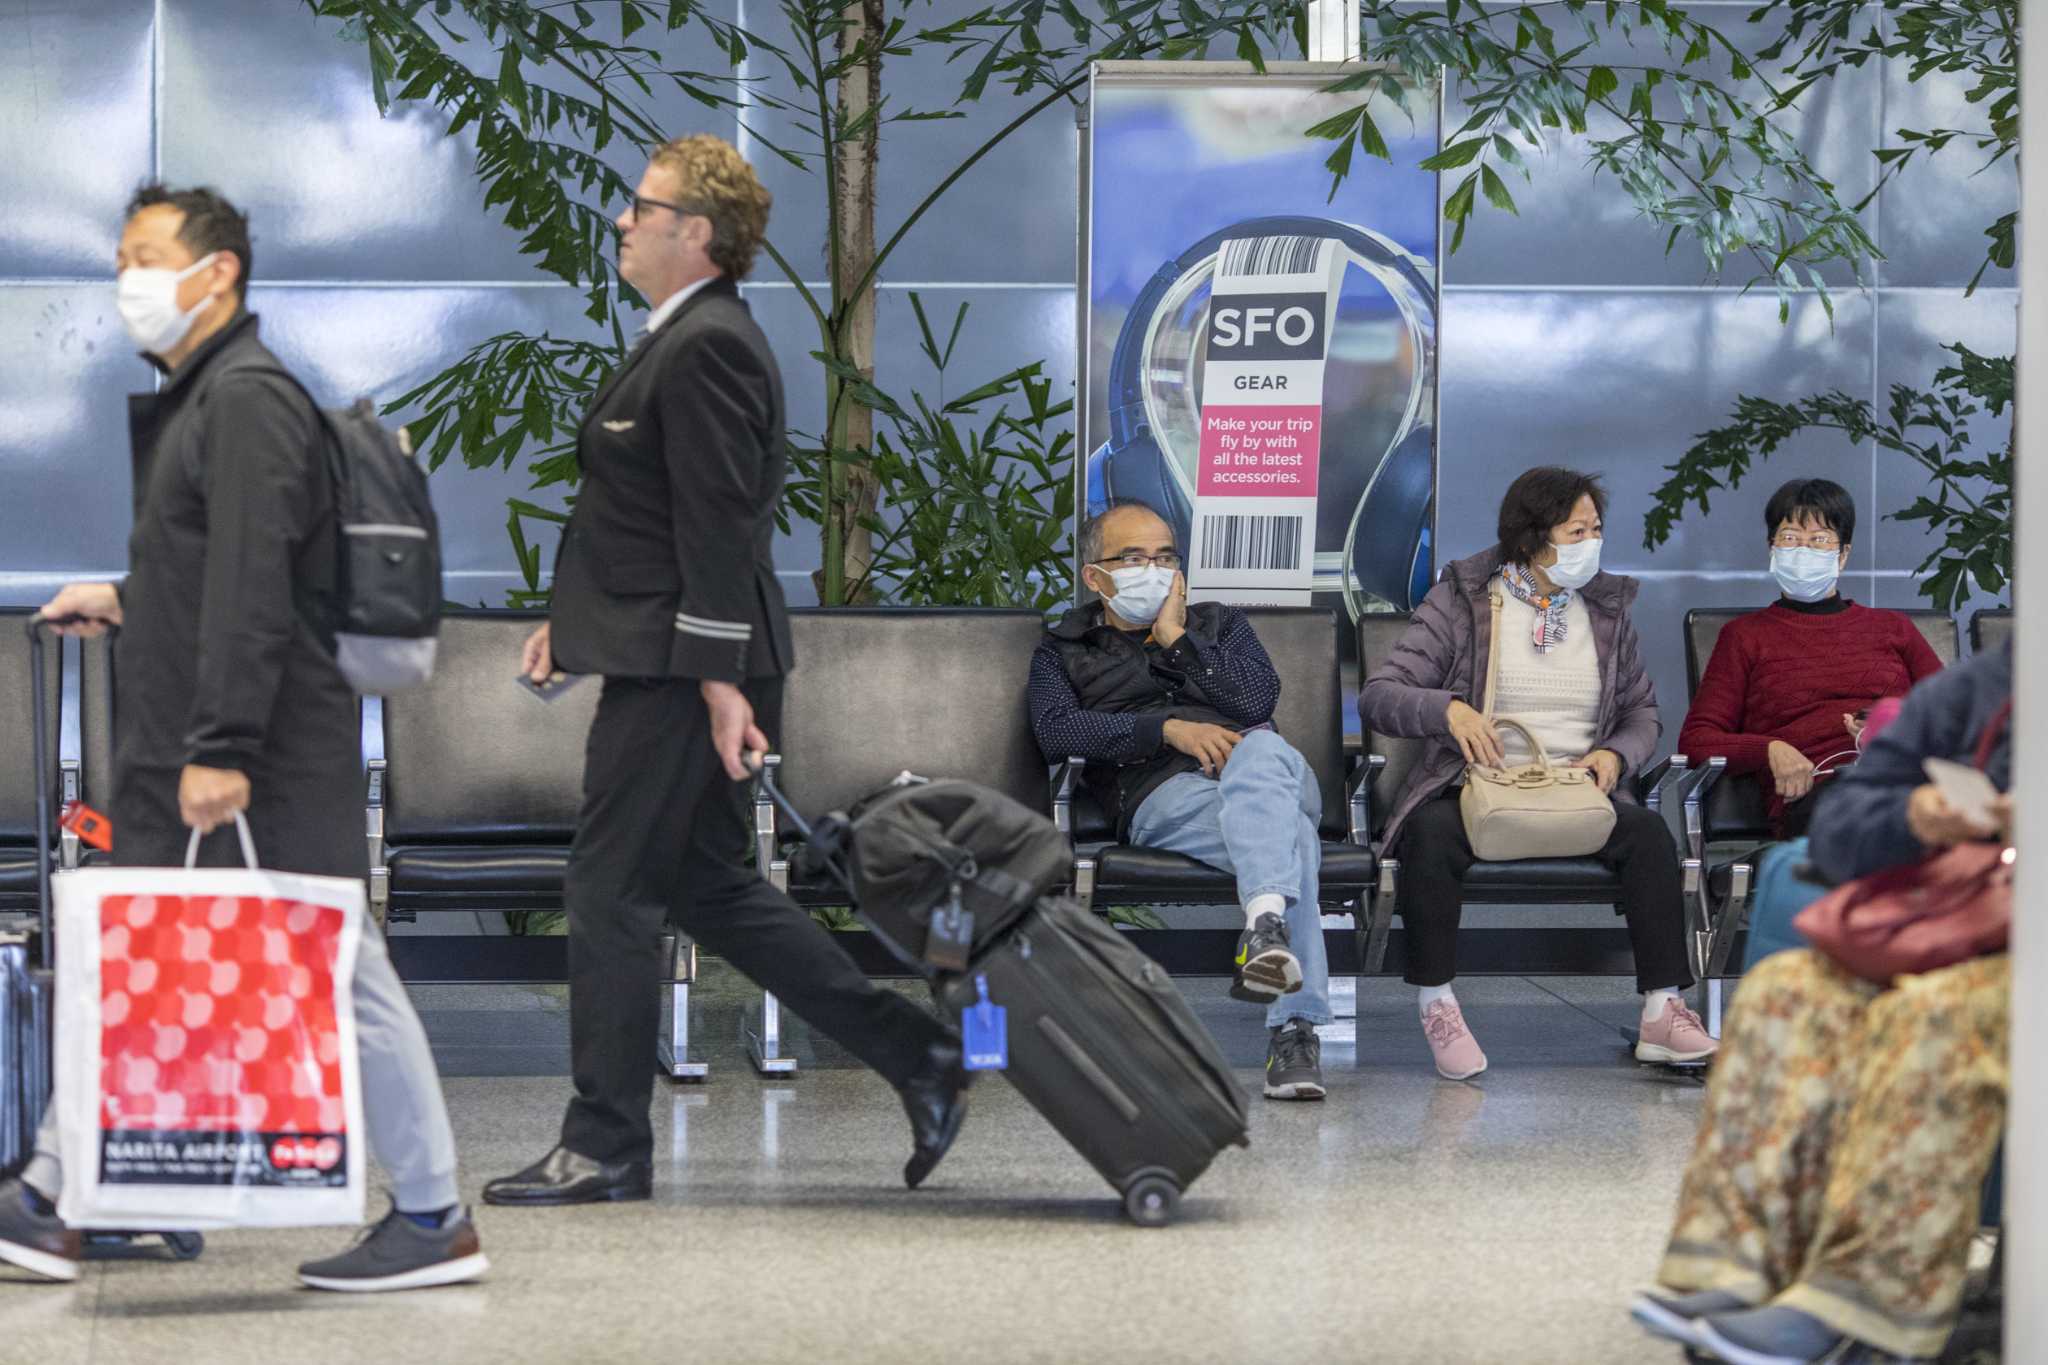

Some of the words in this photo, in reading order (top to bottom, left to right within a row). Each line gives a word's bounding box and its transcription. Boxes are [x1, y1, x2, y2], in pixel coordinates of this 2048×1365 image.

[1212, 306, 1315, 347] SFO
[1234, 375, 1288, 390] GEAR
[1207, 417, 1246, 430] Make
[1250, 420, 1283, 433] your
[1287, 417, 1313, 433] trip
[1220, 434, 1239, 450] fly
[1243, 434, 1261, 450] by
[1265, 434, 1297, 448] with
[1213, 452, 1230, 465] all
[1234, 452, 1258, 465] the
[1262, 452, 1303, 466] latest
[1212, 470, 1301, 483] accessories.
[105, 1141, 179, 1160] NARITA
[182, 1142, 264, 1161] AIRPORT
